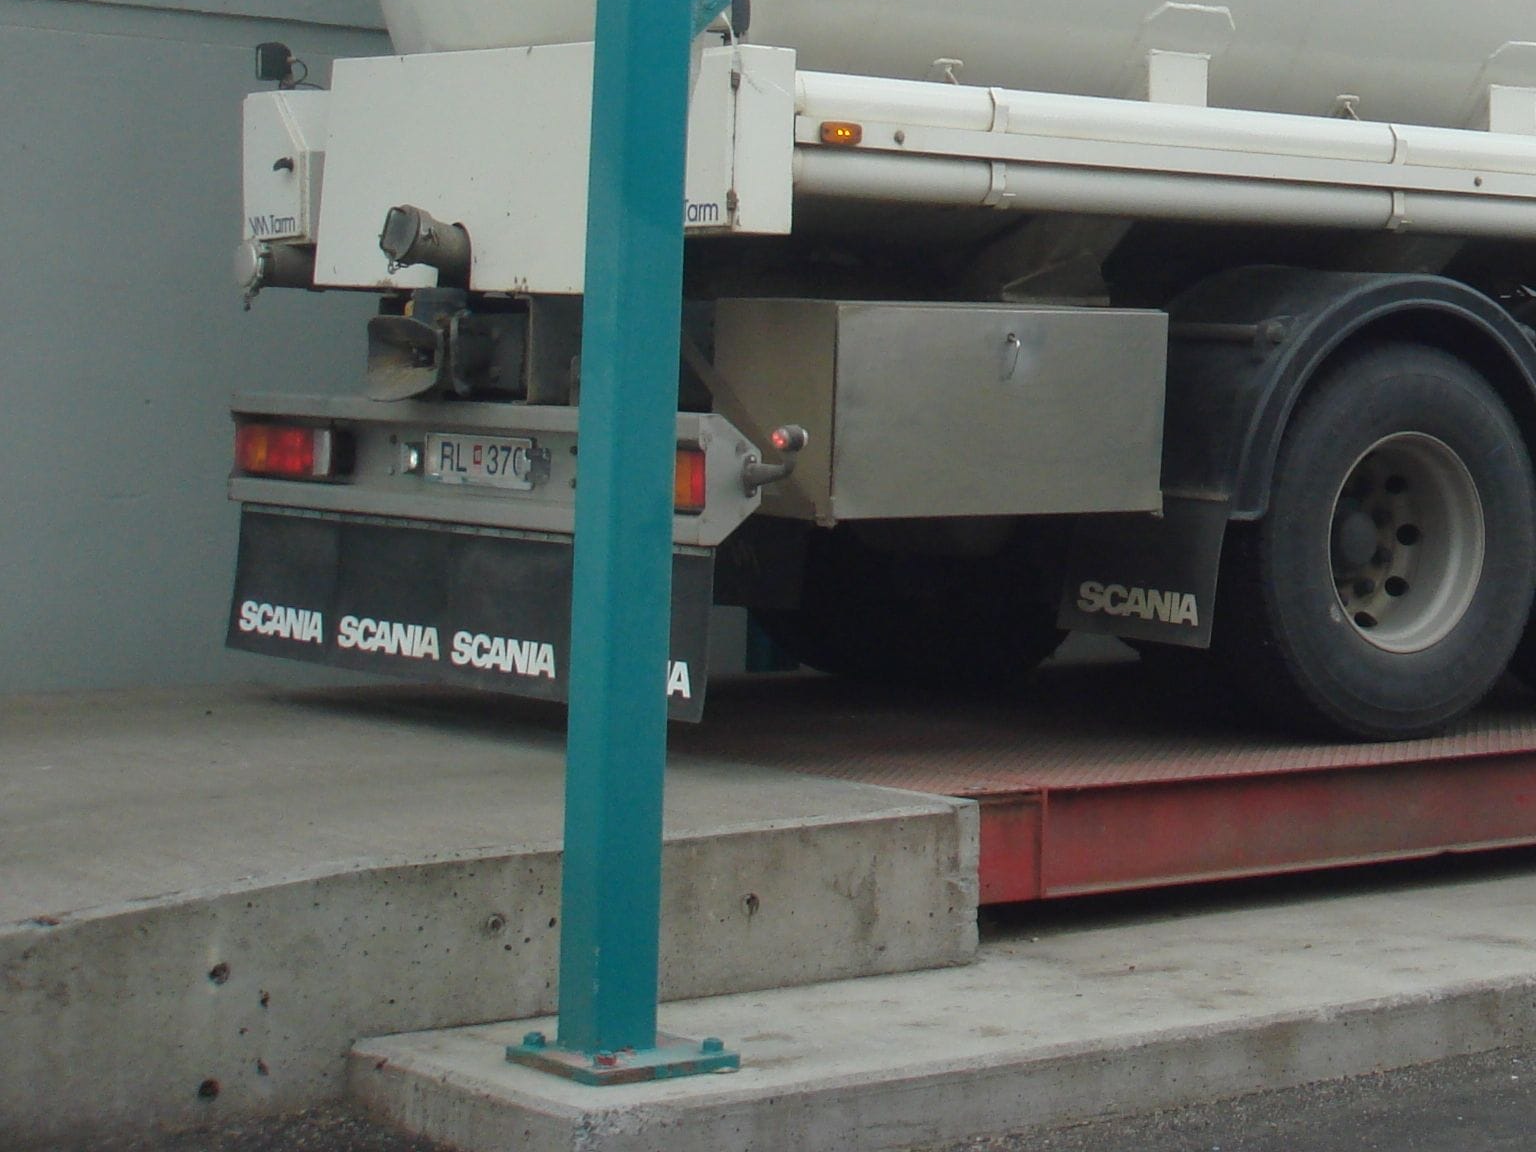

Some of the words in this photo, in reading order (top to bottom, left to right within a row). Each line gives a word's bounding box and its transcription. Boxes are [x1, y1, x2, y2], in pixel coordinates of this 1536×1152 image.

[440, 441, 467, 472] RL
[1077, 581, 1199, 627] SCANIA
[239, 600, 323, 644] SCANIA
[337, 615, 440, 661] SCANIA
[451, 630, 556, 679] SCANIA
